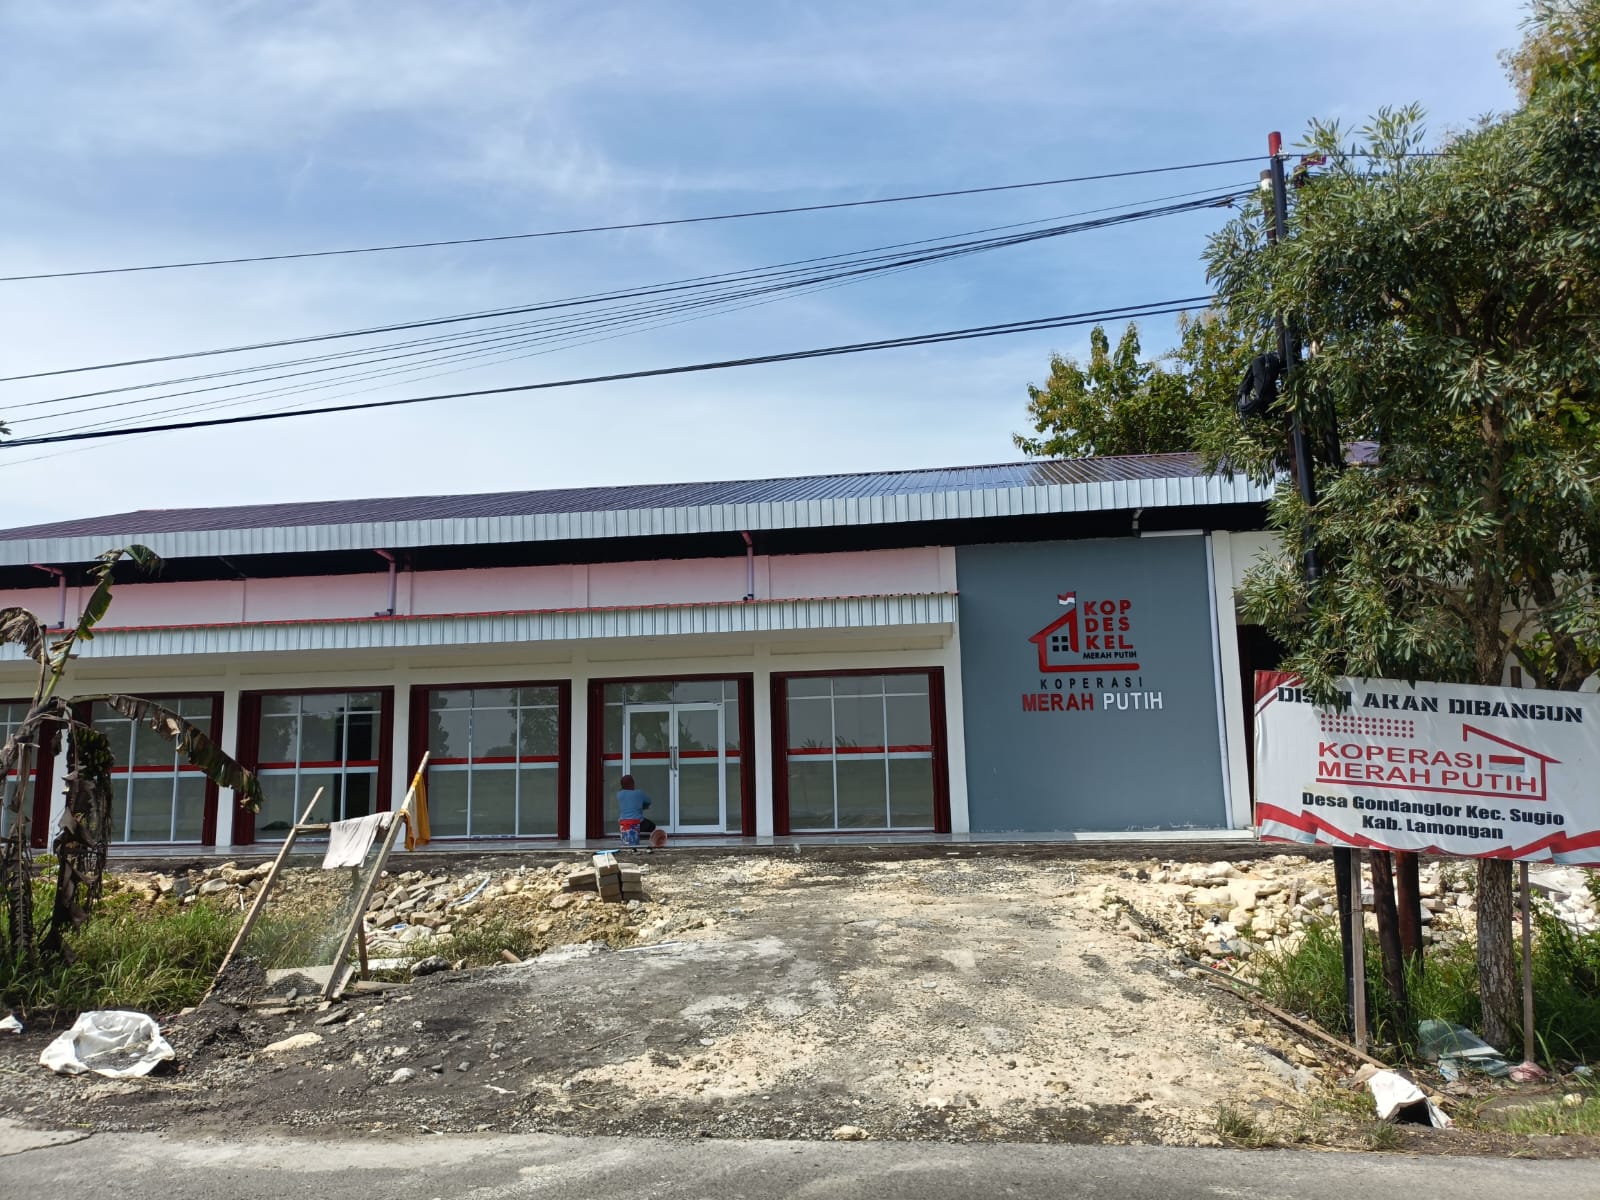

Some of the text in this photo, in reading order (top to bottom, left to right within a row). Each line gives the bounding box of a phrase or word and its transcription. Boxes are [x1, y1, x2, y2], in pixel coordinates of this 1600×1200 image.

[1084, 599, 1131, 616] KOP
[1085, 617, 1130, 632] DES
[1086, 635, 1133, 650] KEL
[1083, 651, 1137, 660] MERAH PUTIH
[1040, 677, 1143, 690] KOPERASI
[1022, 692, 1163, 712] MERAH PUTIH
[1363, 692, 1438, 712] AKAN
[1447, 698, 1583, 723] DIBANGUN
[1318, 742, 1482, 770] KOPERASI
[1318, 761, 1537, 793] MERAH PUTIH
[1302, 792, 1564, 826] Desa Gondanglor Kec. Sugio
[1362, 815, 1504, 839] Kab. Lamongan
